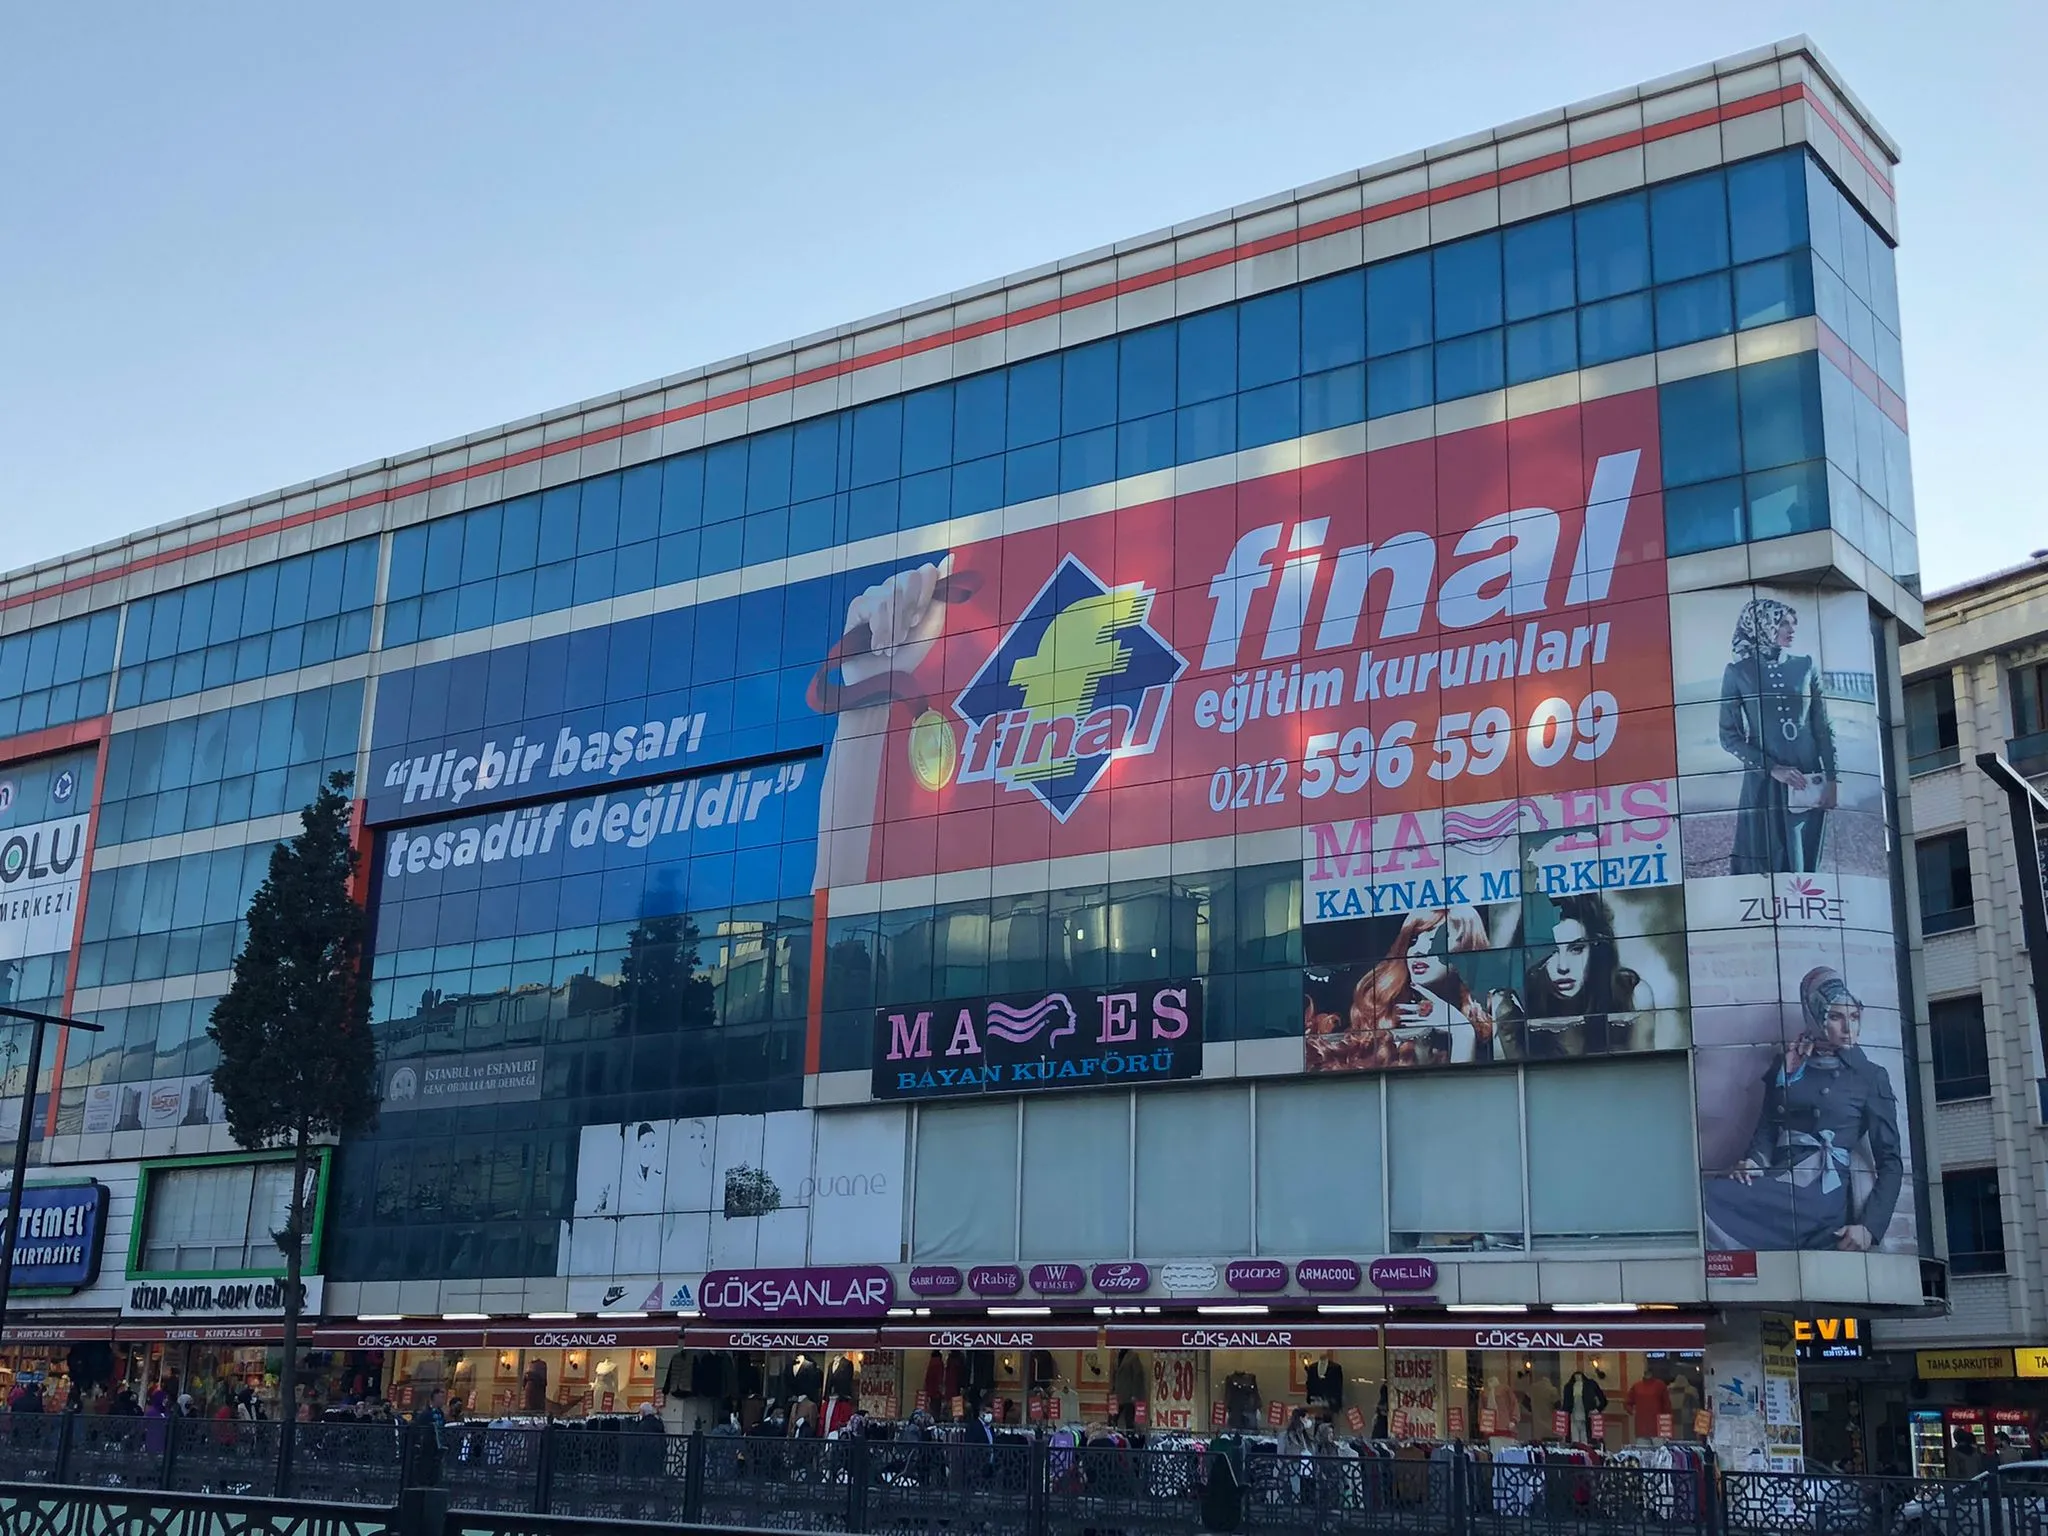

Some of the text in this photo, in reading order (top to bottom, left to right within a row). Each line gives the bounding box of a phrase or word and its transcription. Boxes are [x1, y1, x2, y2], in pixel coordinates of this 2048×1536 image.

[1200, 448, 1642, 671] final
[1193, 621, 1611, 734] eğitim kurumları
[550, 711, 708, 777] başarı
[960, 687, 1170, 780] final
[1208, 690, 1619, 812] 0212 596 59 09
[387, 801, 568, 878] tesadüf
[1315, 843, 1668, 919] KAYNAK MRKEZİ
[1740, 896, 1846, 922] ZÜHRE
[425, 1060, 538, 1081] İSTANBUL ve ESENYURT
[897, 1047, 1174, 1090] BAYAN KUAFÖRÜ
[19, 1205, 84, 1238] TEMEL
[12, 1243, 81, 1265] KIRTASİYE
[911, 1274, 957, 1286] SABRİ ÖZEL
[1299, 1268, 1355, 1281] ARMACOOL
[669, 1299, 695, 1307] adidas
[703, 1276, 886, 1311] GÖKŞANLAR
[17, 1329, 66, 1338] KIRTASİYE
[165, 1328, 262, 1339] TEMEL KIRTASİYE
[357, 1333, 438, 1347] GÖKŞANLAR
[534, 1332, 617, 1347] GÖKŞANLAR
[729, 1332, 829, 1347] GÖKŞANLAR
[929, 1332, 1034, 1347] GÖKŞANLAR
[1182, 1330, 1292, 1348] GÖKŞANLAR
[1475, 1330, 1604, 1348] GÖKŞANLAR
[1926, 1359, 1950, 1370] TAHA
[1173, 1361, 1194, 1401] 30
[1156, 1409, 1191, 1428] NET
